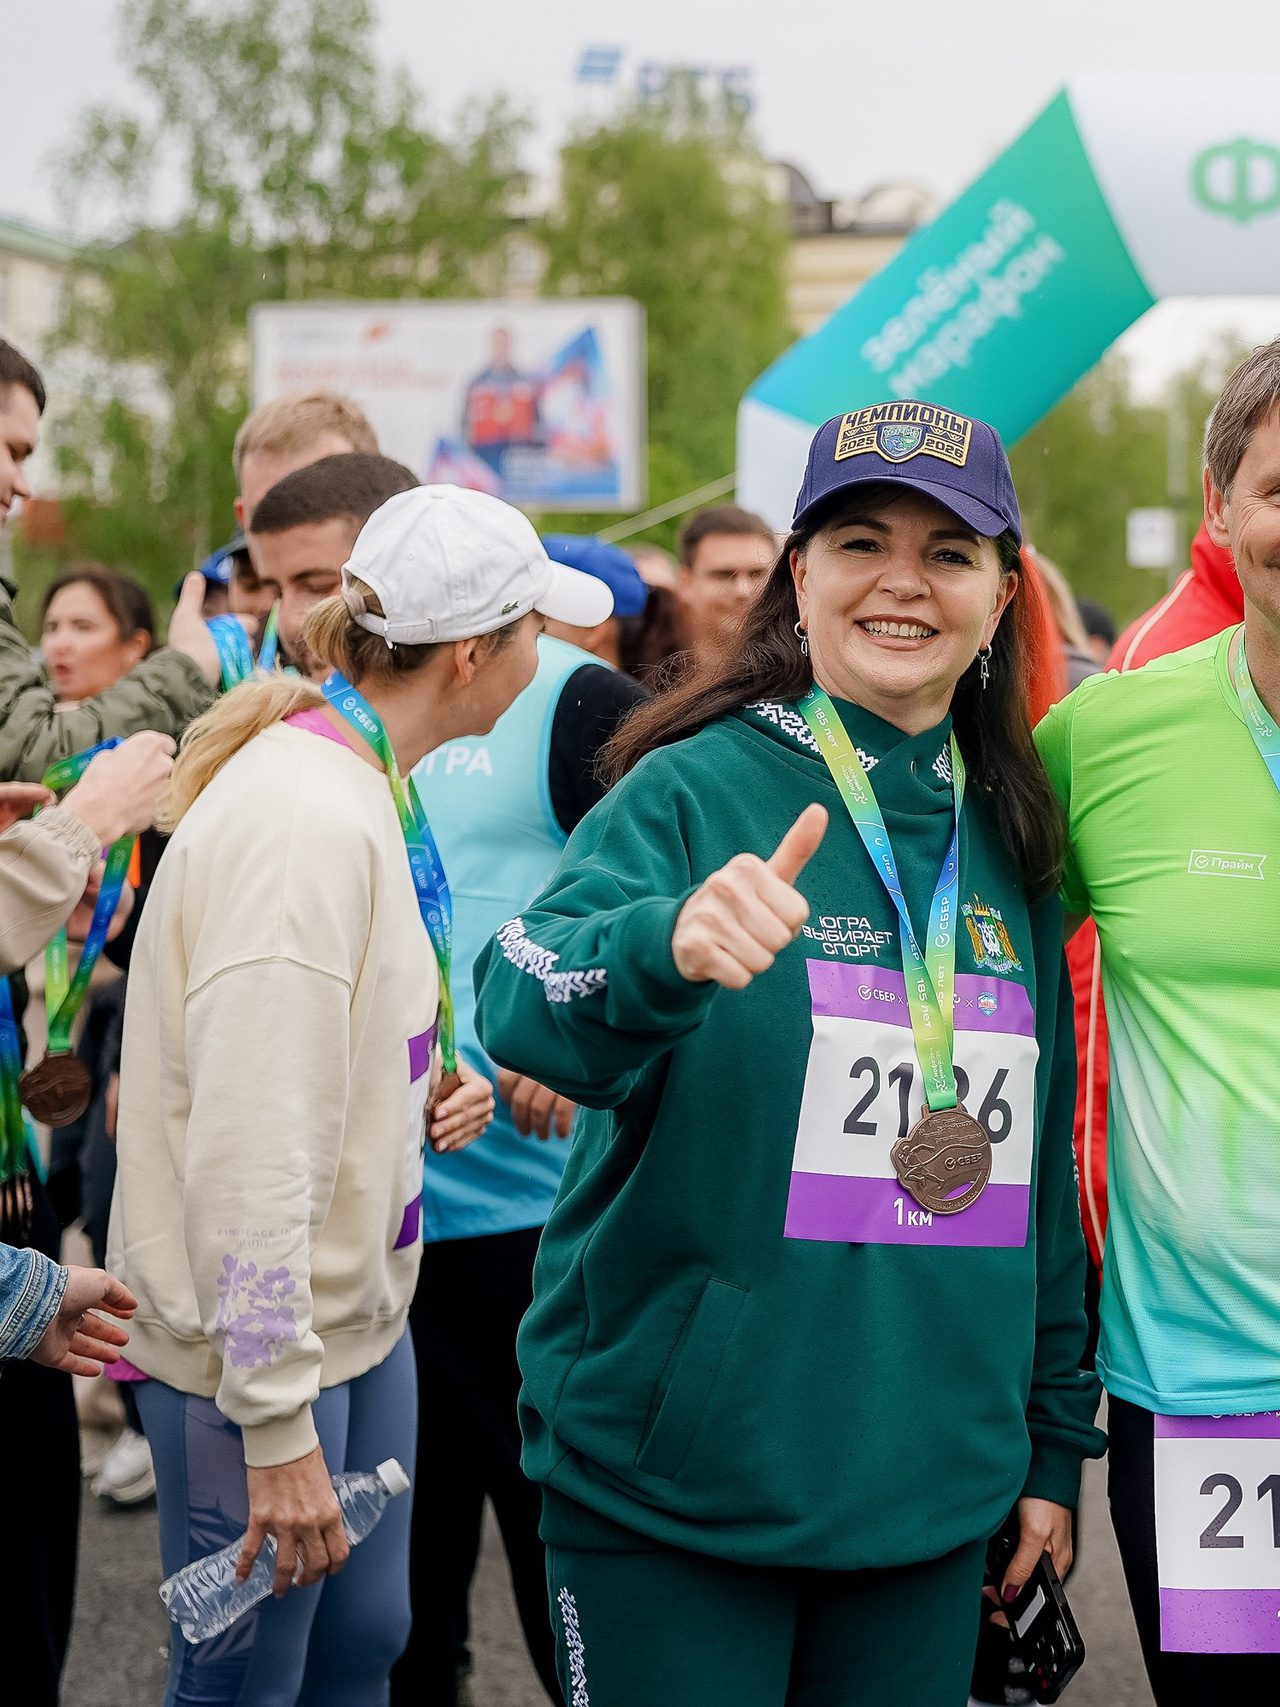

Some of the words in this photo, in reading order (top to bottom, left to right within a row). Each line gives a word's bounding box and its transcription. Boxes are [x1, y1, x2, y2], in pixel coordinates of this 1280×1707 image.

[860, 199, 1035, 373] зелёный
[888, 233, 1064, 398] марафон
[846, 404, 968, 435] ЧЕМПИОНЫ
[840, 436, 875, 451] 2025
[925, 439, 964, 458] 2026
[353, 708, 379, 735] СБЕР
[813, 707, 829, 726] 185
[823, 727, 839, 748] лет
[410, 745, 493, 777] ГРА
[881, 853, 895, 879] Utair
[1211, 857, 1254, 872] Прайм
[819, 916, 871, 929] ЮГРА
[939, 896, 951, 930] СБЕР
[802, 925, 893, 944] ВЫБИРАЕТ
[822, 942, 880, 957] СПОРТ
[937, 964, 945, 988] лет
[873, 988, 896, 1003] СБЕР
[916, 977, 928, 1001] 185
[921, 1005, 932, 1029] лет
[957, 1153, 983, 1166] СБЕР
